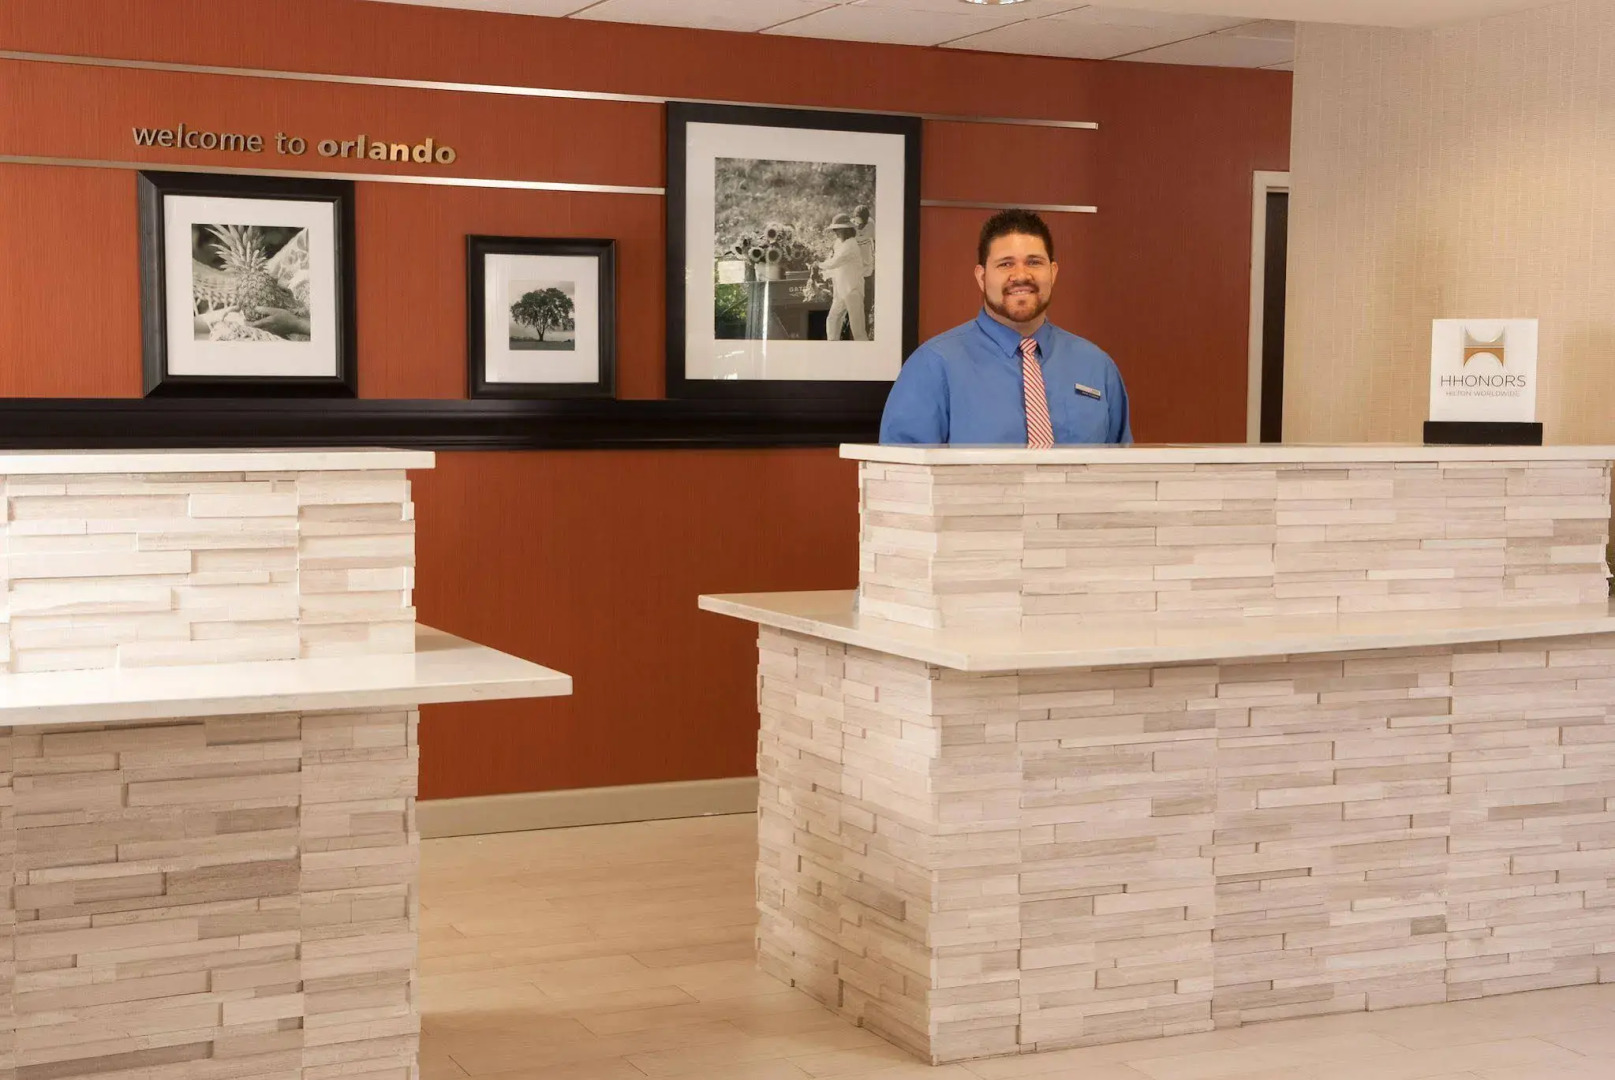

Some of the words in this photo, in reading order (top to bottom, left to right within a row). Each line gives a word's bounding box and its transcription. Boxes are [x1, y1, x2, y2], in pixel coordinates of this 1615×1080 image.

[132, 123, 263, 152] welcome
[275, 132, 305, 155] to
[317, 135, 456, 164] orlando
[1441, 375, 1526, 387] HHONORS
